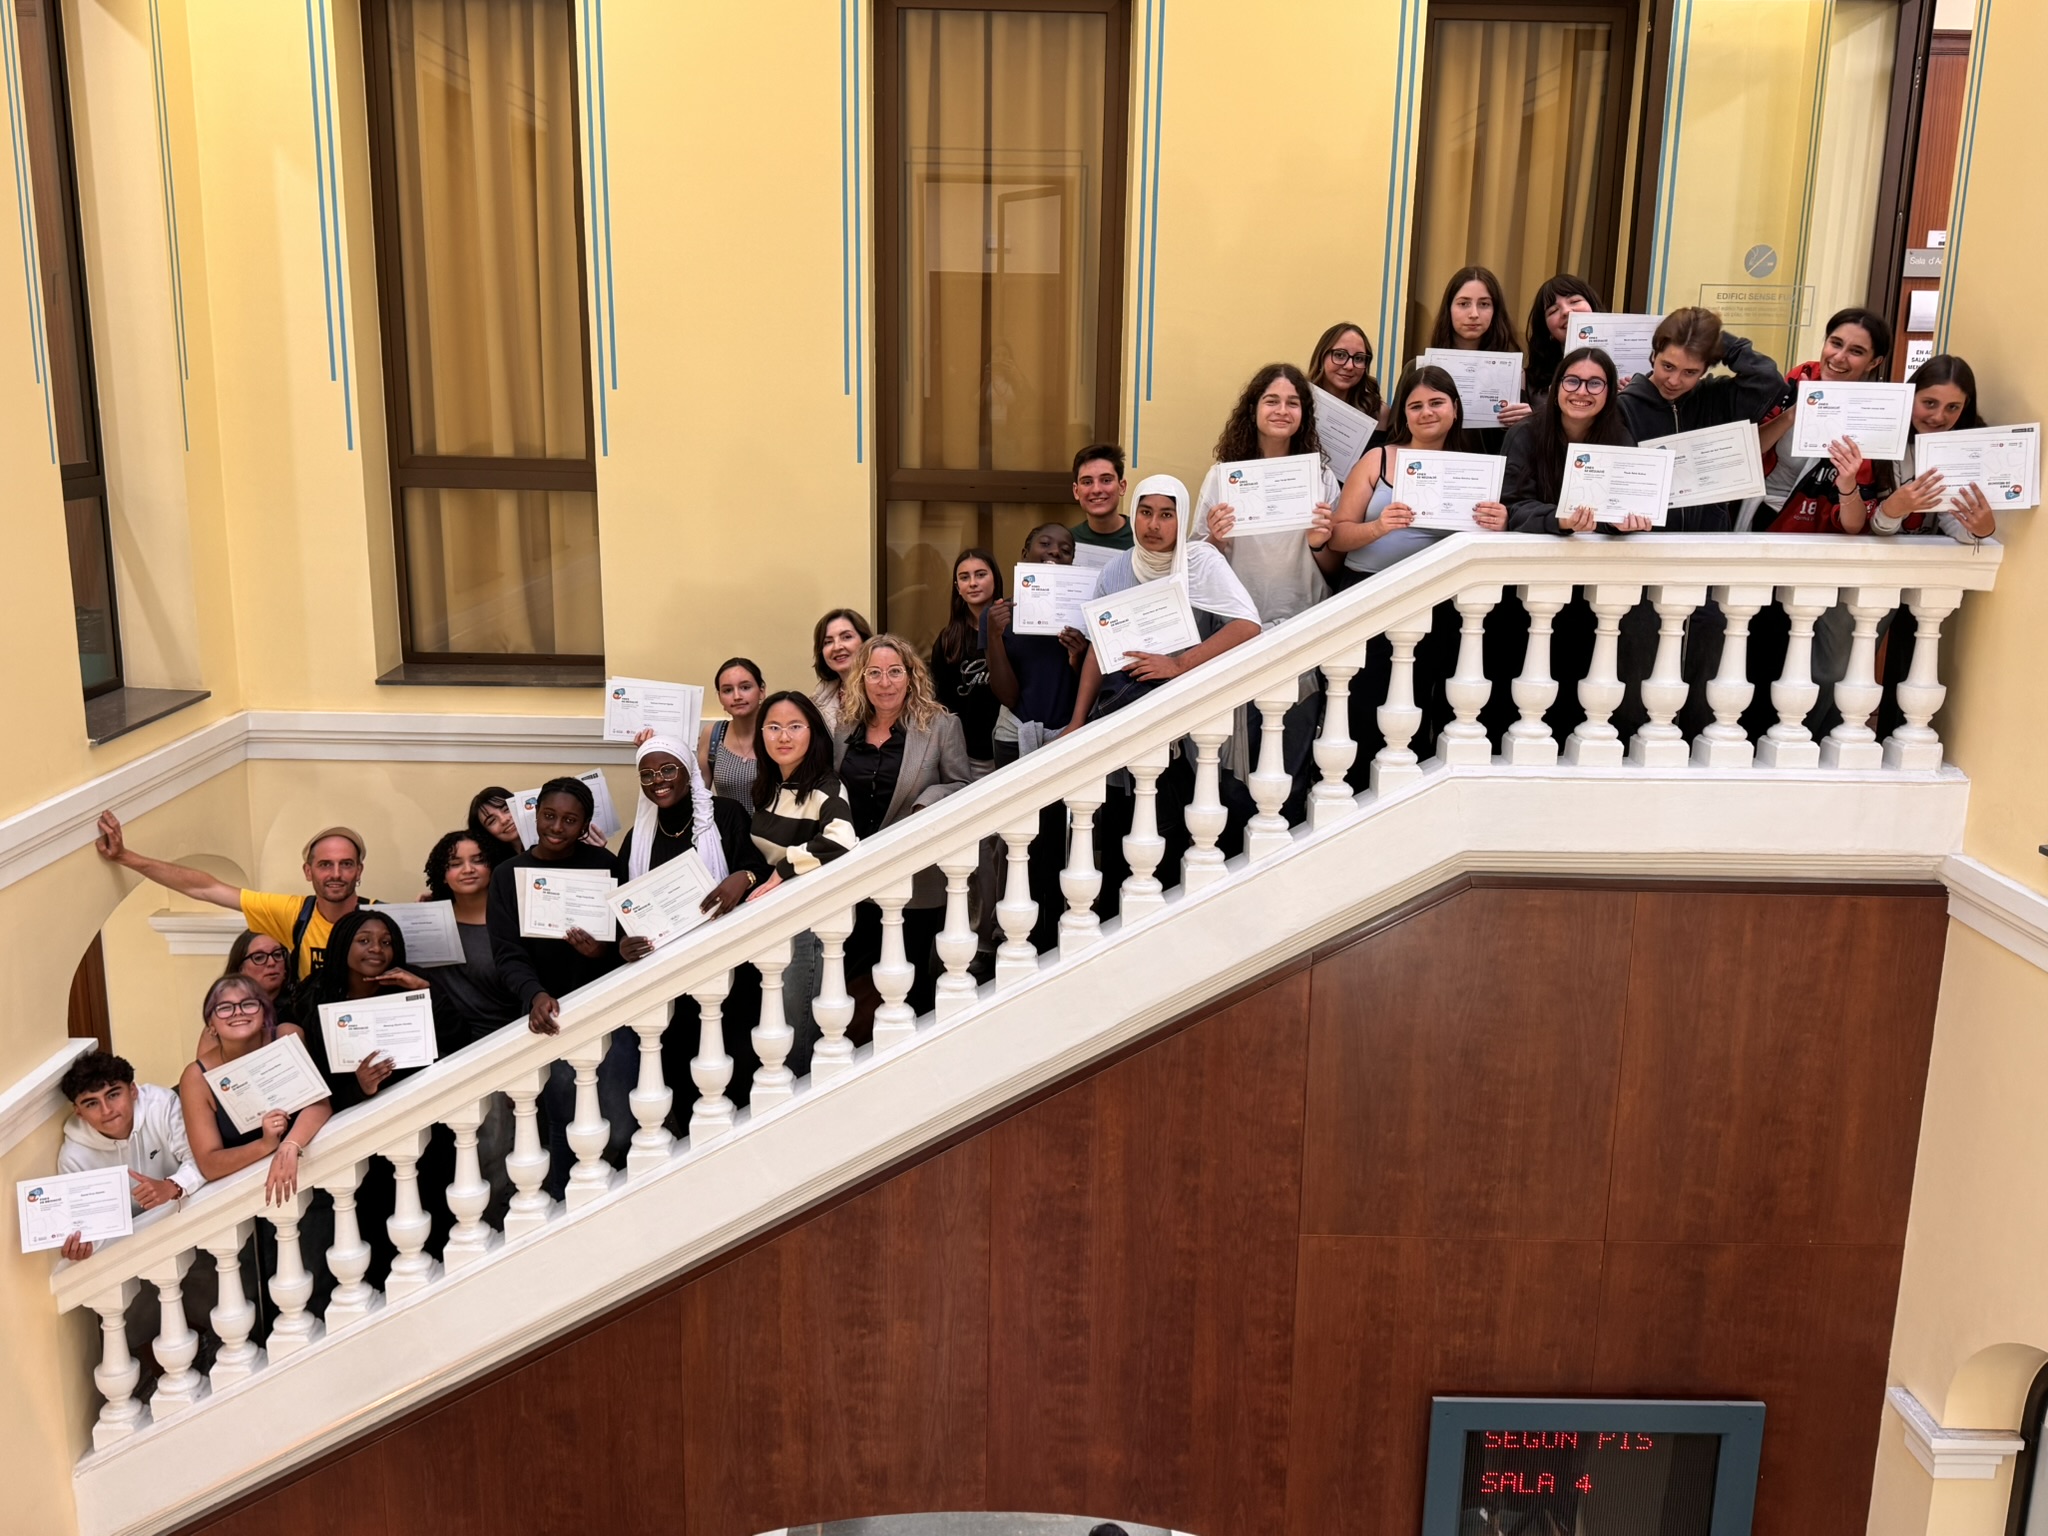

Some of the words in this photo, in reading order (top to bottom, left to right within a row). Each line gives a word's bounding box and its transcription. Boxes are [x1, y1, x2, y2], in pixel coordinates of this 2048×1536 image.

[1910, 256, 1926, 265] Sala
[1716, 292, 1747, 301] EDIFICI
[1748, 293, 1776, 301] SENSE
[1799, 500, 1817, 515] 18
[1481, 1472, 1555, 1494] SALA
[1575, 1473, 1592, 1494] 4
